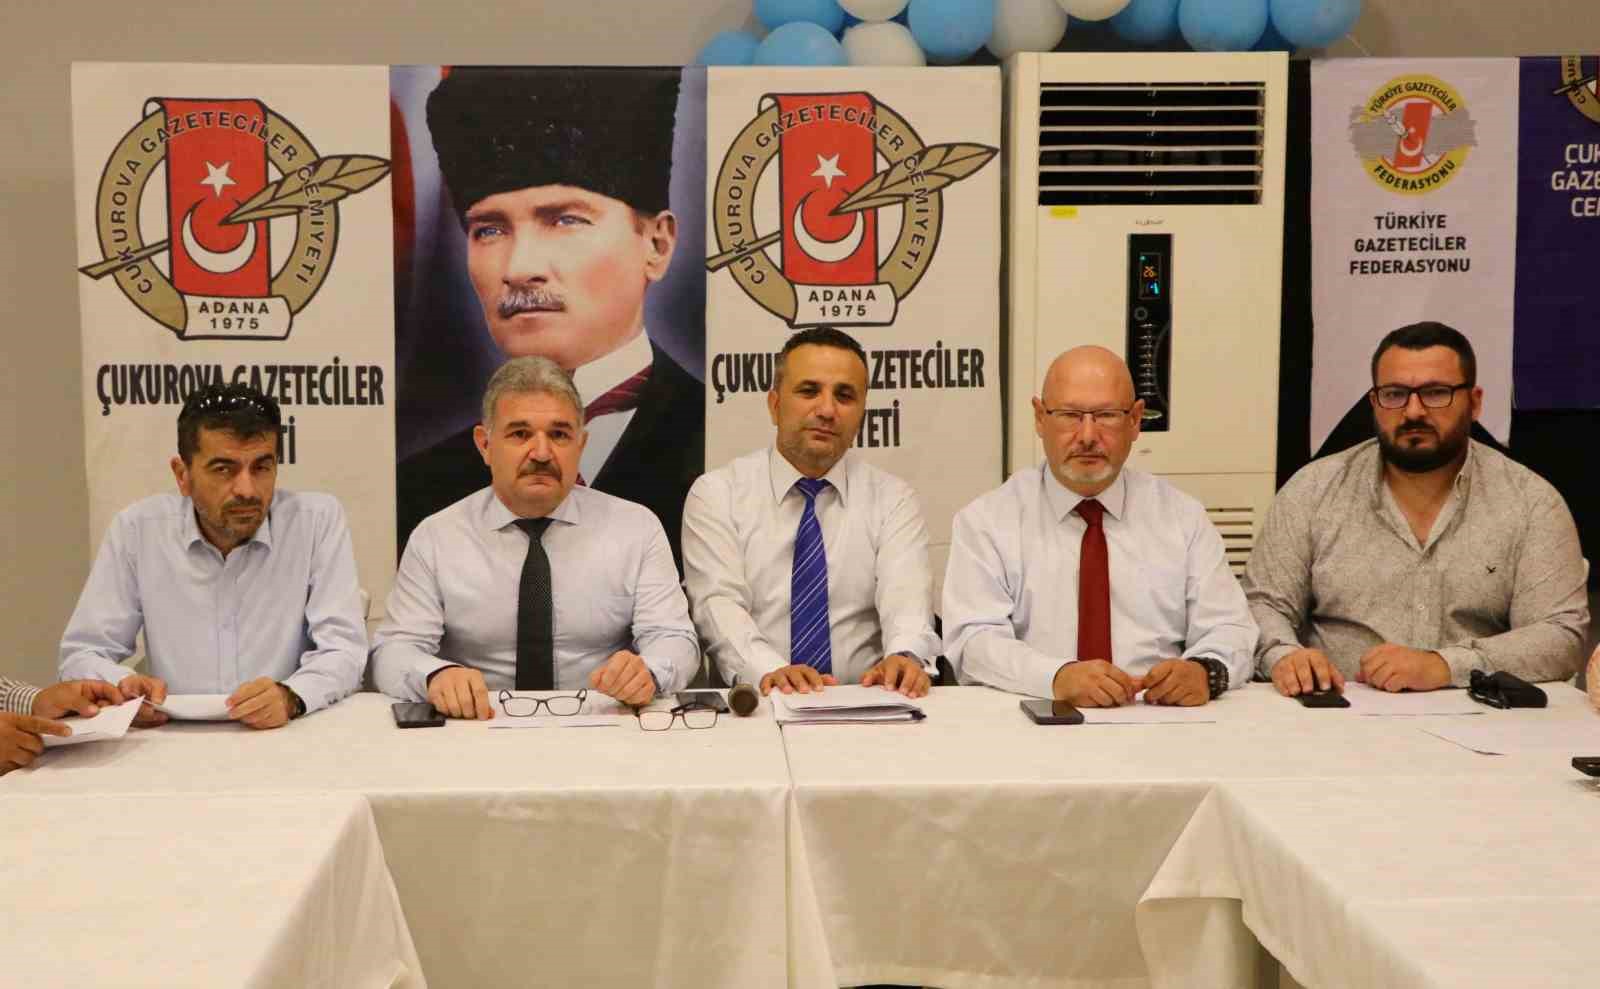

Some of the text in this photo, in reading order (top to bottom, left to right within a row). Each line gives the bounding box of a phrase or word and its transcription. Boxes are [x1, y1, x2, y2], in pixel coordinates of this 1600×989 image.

[1374, 159, 1456, 190] FEDERASYONU
[1374, 211, 1447, 230] TÜRKİYE
[1354, 233, 1466, 253] GAZETECİLER
[1350, 258, 1470, 275] FEDERASYONU
[809, 290, 876, 302] ADANA
[199, 301, 270, 314] ADANA
[820, 305, 866, 317] 1975
[210, 318, 259, 330] 1975
